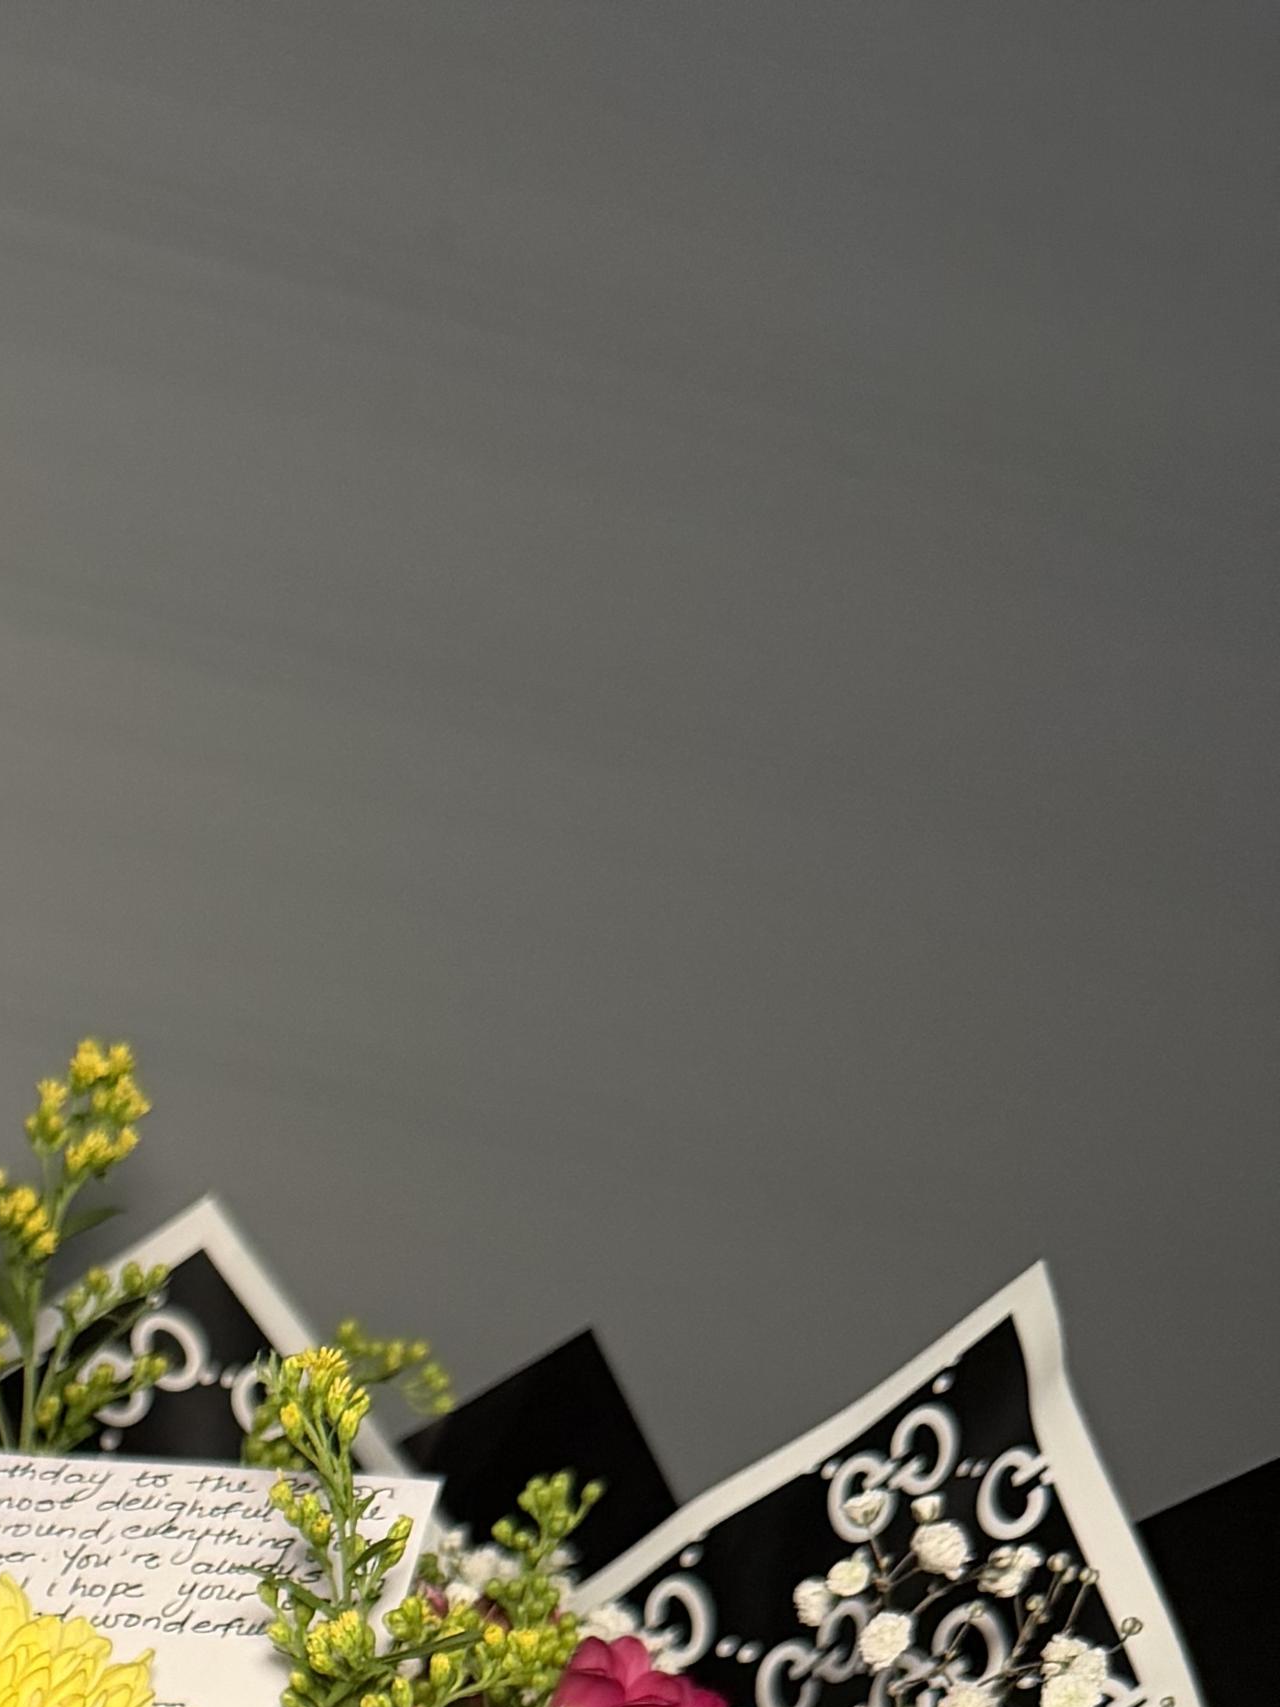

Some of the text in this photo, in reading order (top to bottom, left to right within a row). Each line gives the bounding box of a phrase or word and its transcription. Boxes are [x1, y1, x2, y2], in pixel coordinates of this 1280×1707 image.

[130, 1470, 173, 1488] to
[187, 1475, 257, 1494] the
[60, 1543, 161, 1576] You're
[191, 1558, 324, 1584] always
[121, 1524, 296, 1567] everything
[69, 1577, 144, 1607] hope
[161, 1581, 257, 1618] your
